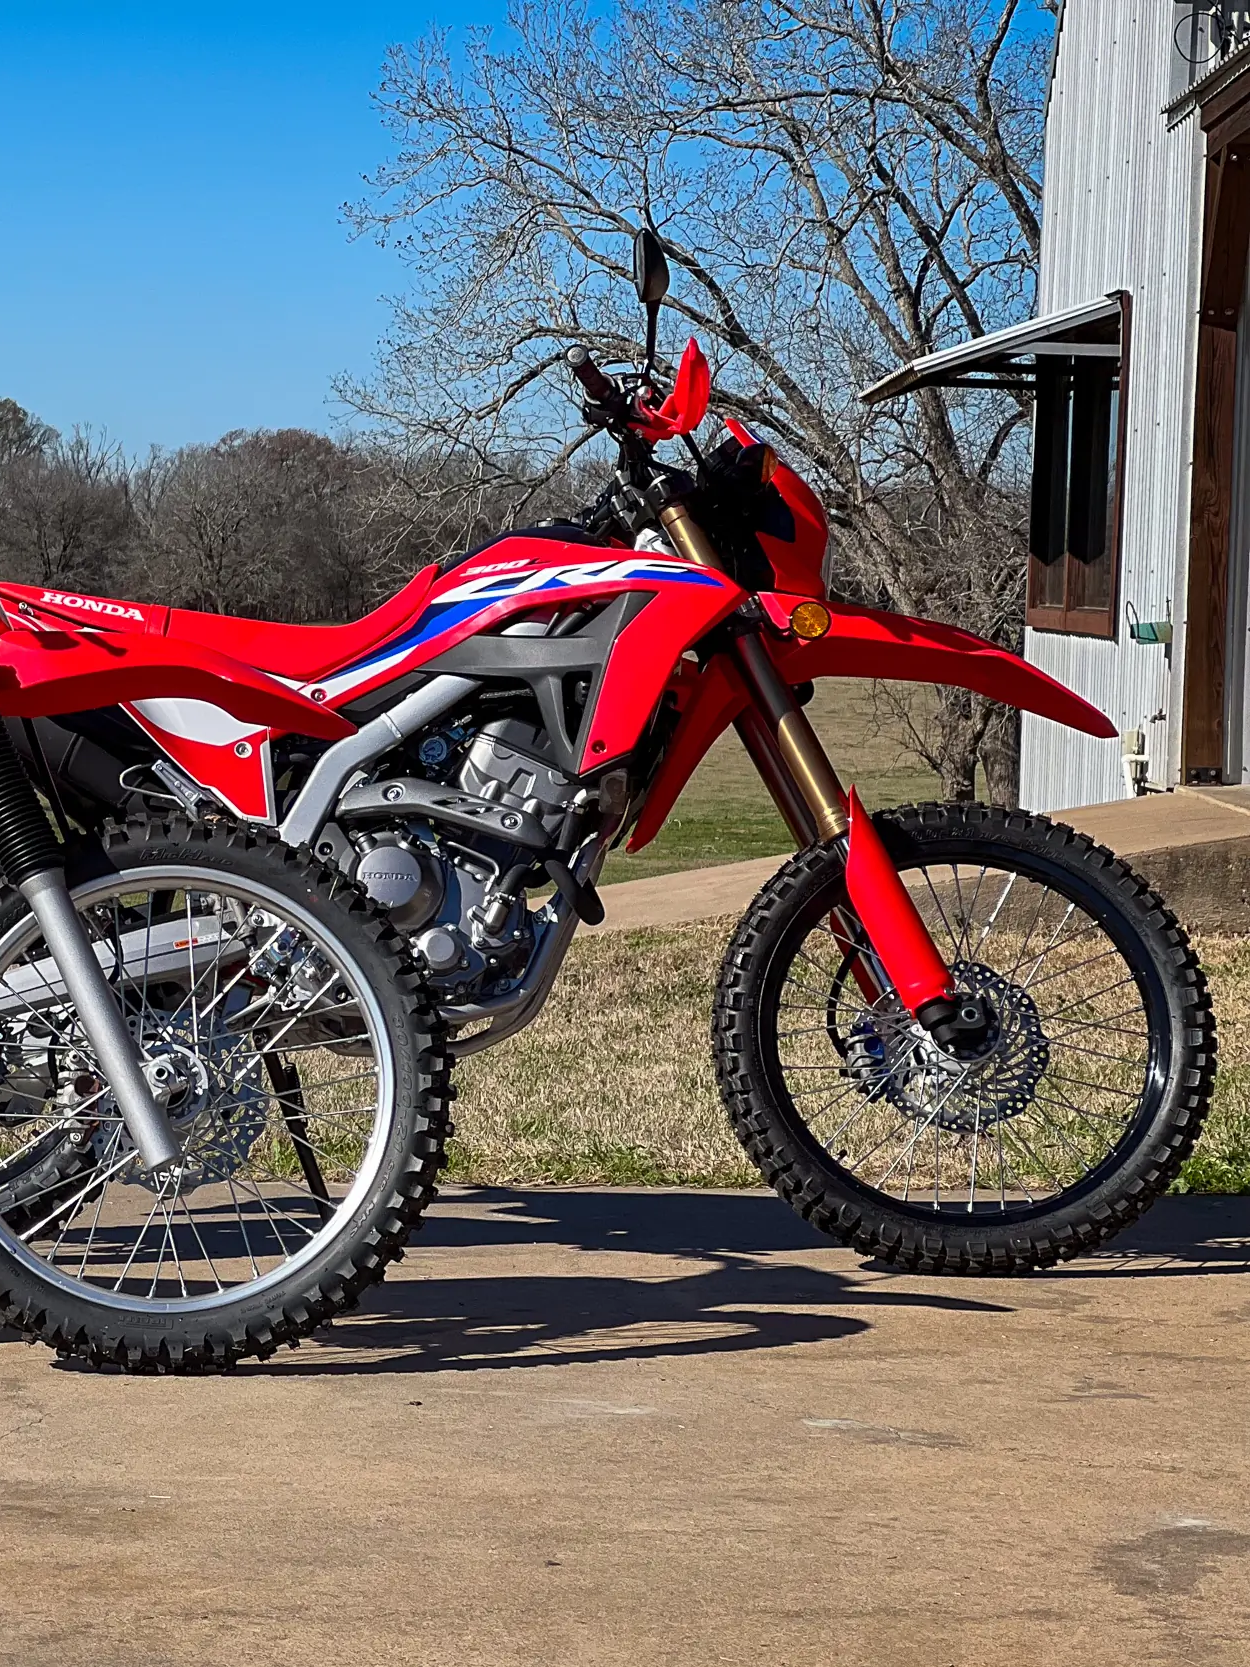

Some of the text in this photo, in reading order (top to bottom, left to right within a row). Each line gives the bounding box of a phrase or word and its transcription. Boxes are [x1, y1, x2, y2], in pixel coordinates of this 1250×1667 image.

[431, 559, 709, 604] CRF
[40, 591, 145, 622] HONDA
[362, 871, 418, 882] HONDA
